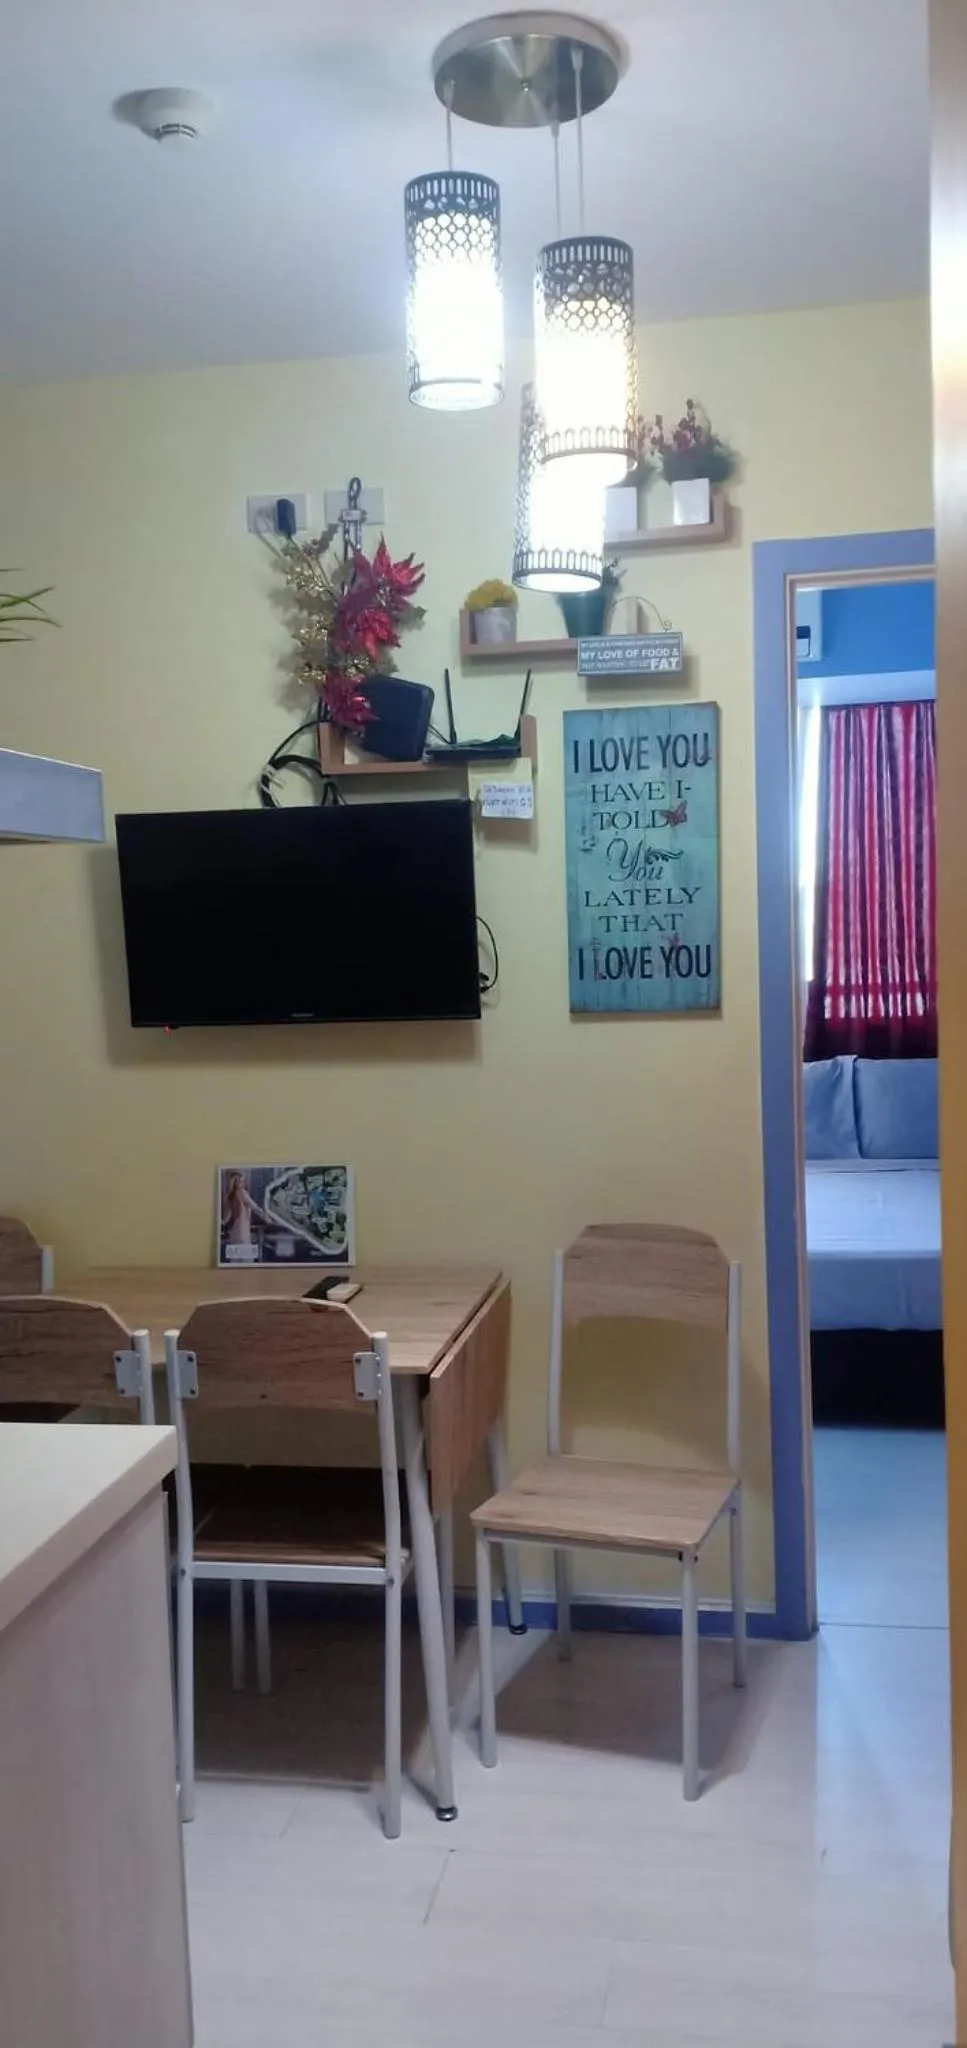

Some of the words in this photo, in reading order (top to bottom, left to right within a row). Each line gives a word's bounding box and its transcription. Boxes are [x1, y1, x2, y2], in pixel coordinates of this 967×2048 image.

[580, 651, 596, 660] MY
[597, 649, 624, 660] LOVE
[625, 649, 638, 658] OF
[641, 647, 670, 657] FOOD
[671, 647, 680, 656] &
[650, 657, 679, 671] FAT
[573, 740, 580, 774] I
[589, 736, 649, 773] LOVE
[656, 732, 712, 770] YOU
[591, 780, 665, 803] HAVE
[593, 810, 670, 831] TOLD
[606, 837, 663, 883] You
[584, 886, 702, 908] LATELY
[598, 912, 684, 934] THAT
[578, 948, 584, 981] I
[594, 946, 652, 981] LOVE
[659, 944, 712, 980] YOU
